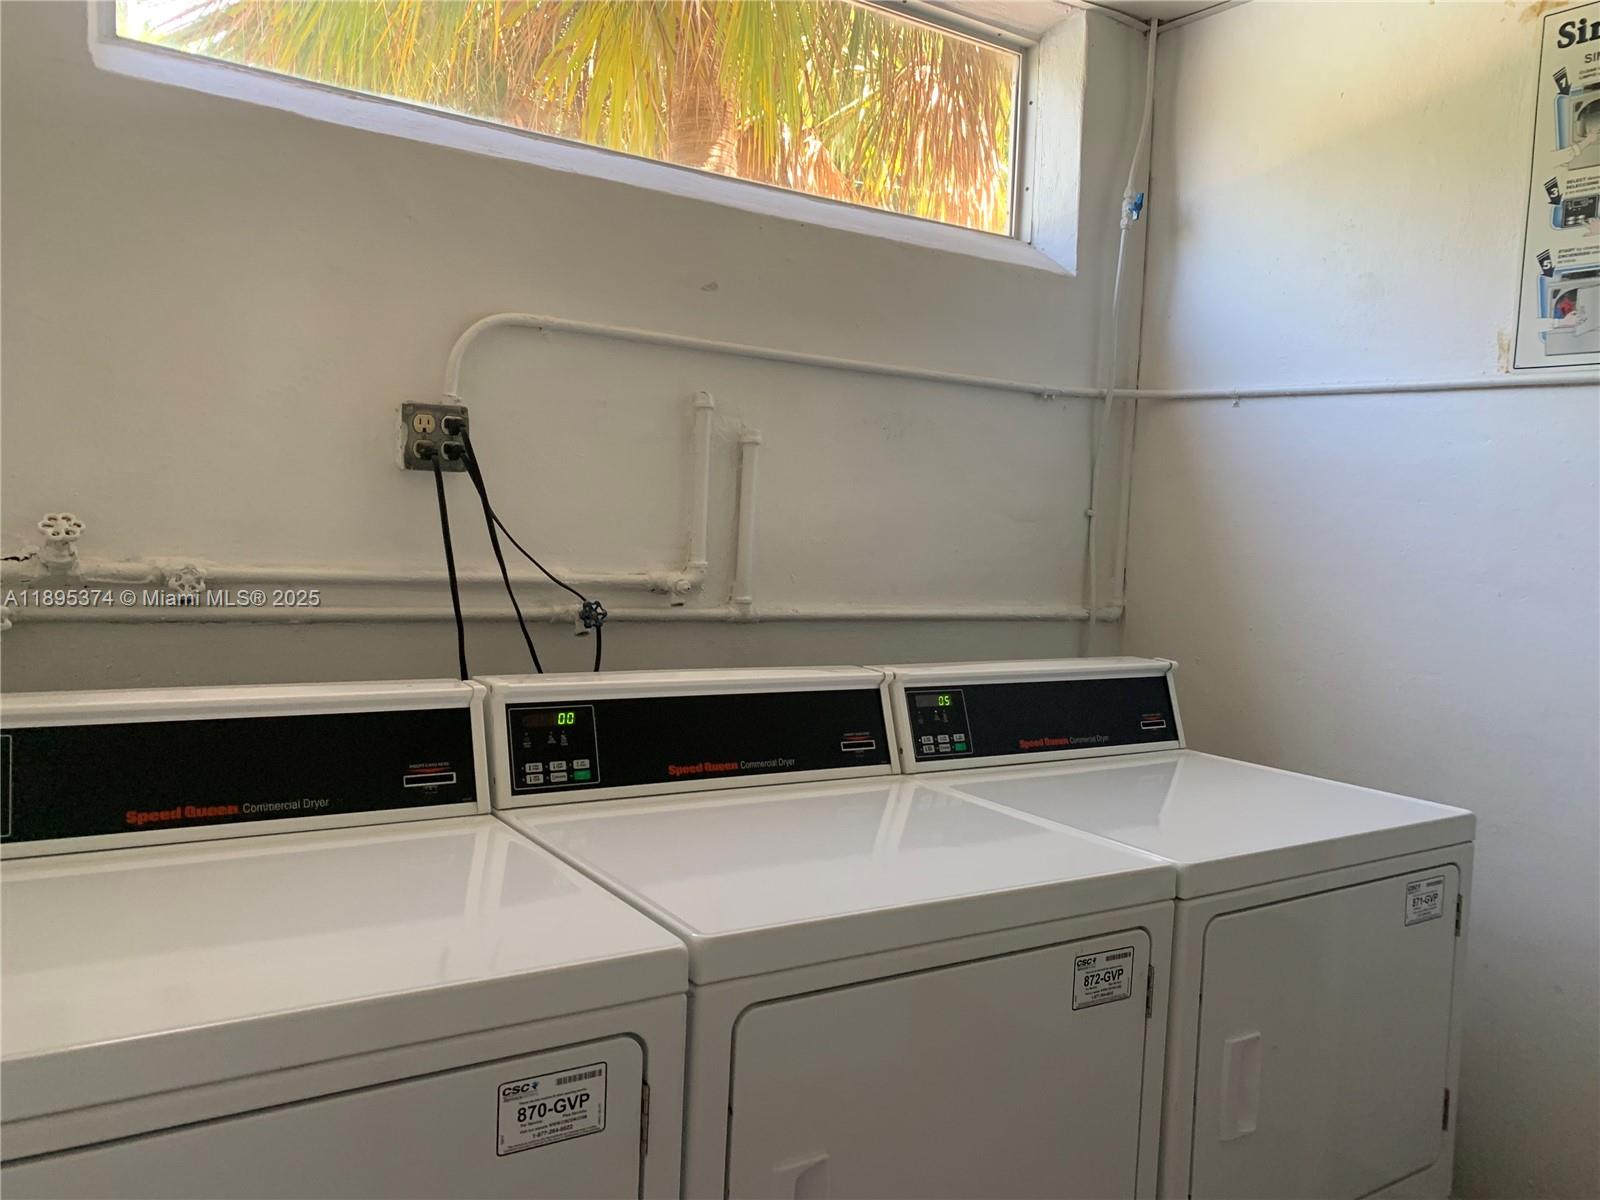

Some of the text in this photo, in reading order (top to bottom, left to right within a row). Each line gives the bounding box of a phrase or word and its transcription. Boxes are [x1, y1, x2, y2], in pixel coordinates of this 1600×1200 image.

[1584, 51, 1600, 64] SI
[1550, 187, 1558, 198] 3
[1543, 260, 1551, 270] 5
[938, 695, 950, 706] 05
[557, 712, 575, 725] 00
[668, 758, 795, 776] Speed Queen Commercial Dryer
[126, 798, 330, 825] Speed Queen Commercial Dryer
[1077, 958, 1092, 967] CSC
[1084, 969, 1124, 987] 872-GVP
[502, 1083, 530, 1097] CSC
[517, 1093, 590, 1122] 870-GVP
